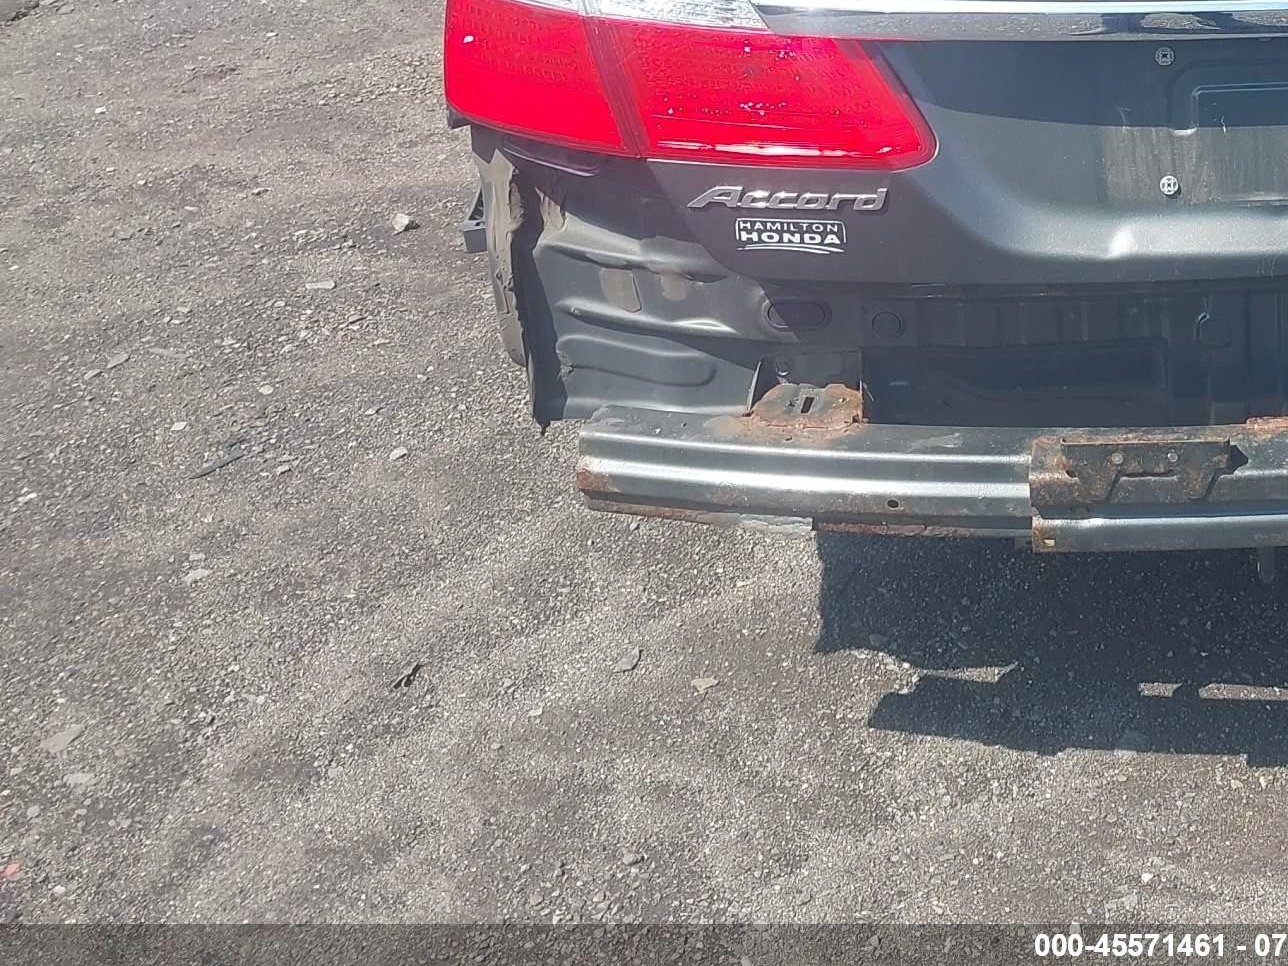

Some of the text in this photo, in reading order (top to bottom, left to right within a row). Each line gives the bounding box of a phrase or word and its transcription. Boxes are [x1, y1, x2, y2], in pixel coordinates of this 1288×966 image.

[687, 185, 888, 211] Accord
[739, 221, 838, 233] HAMILTON
[740, 232, 841, 245] HONDA
